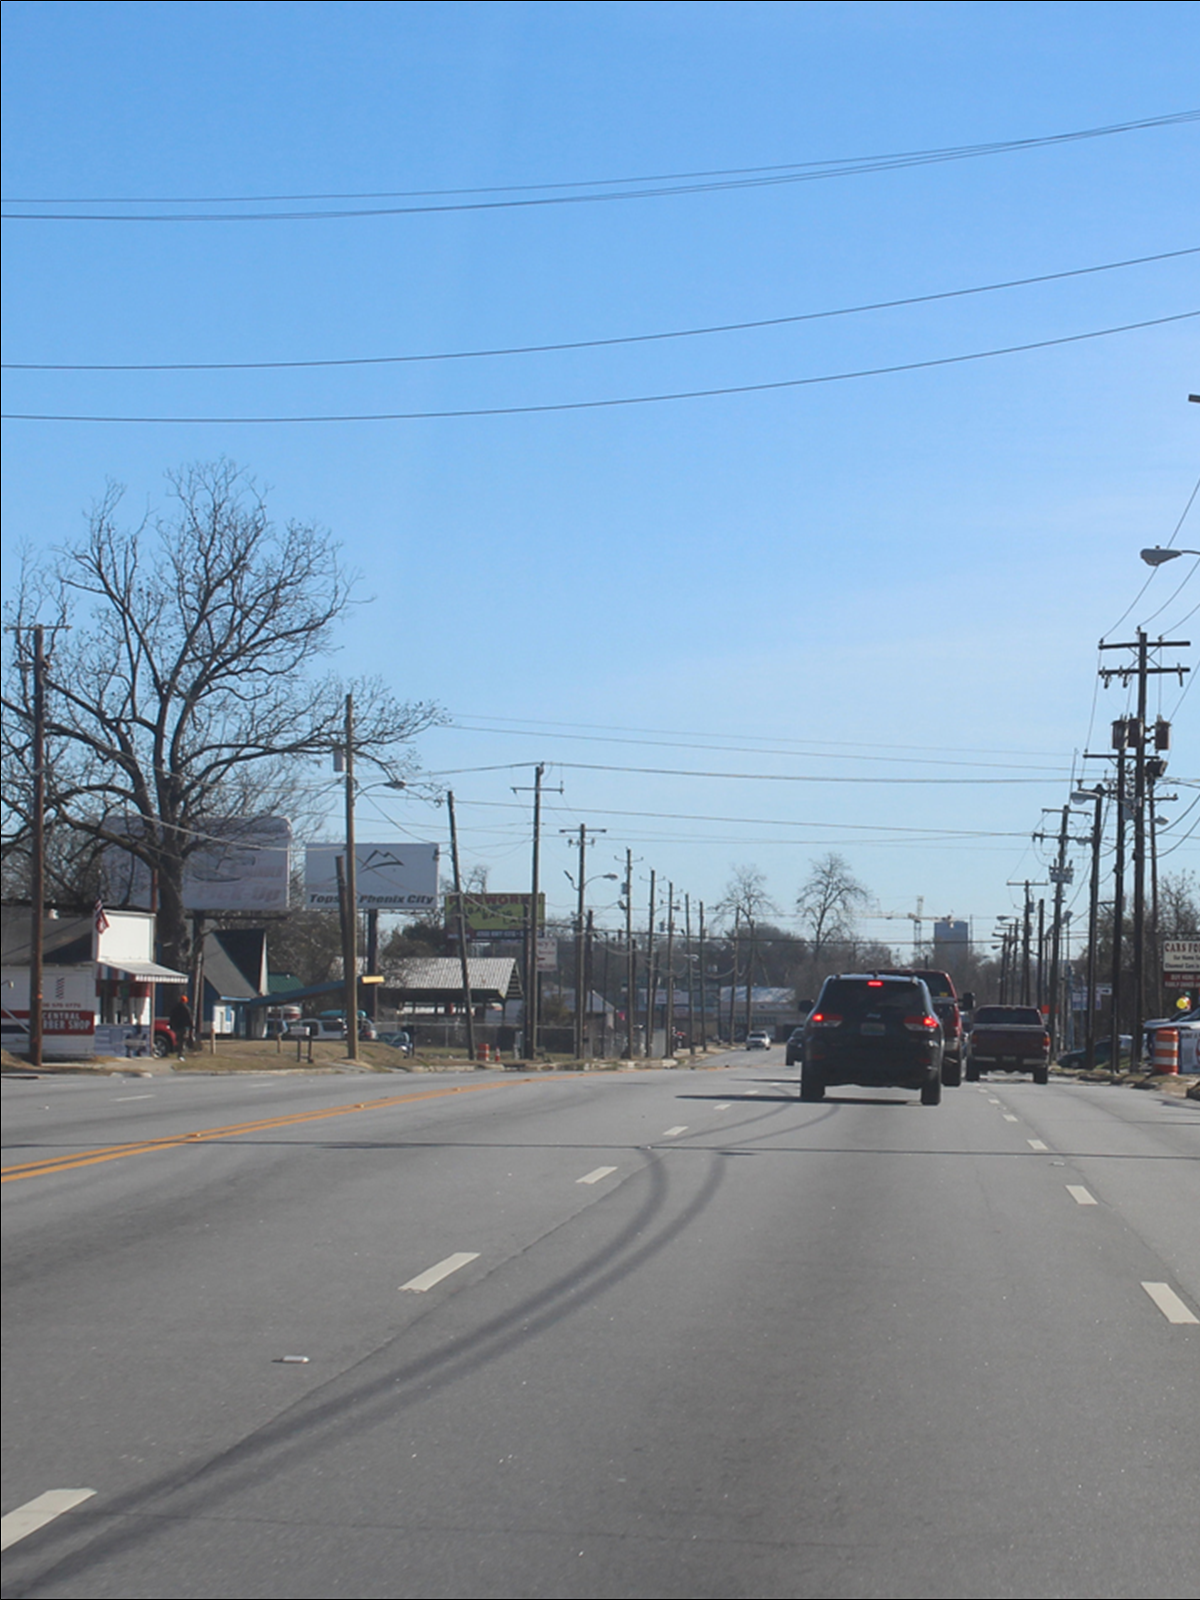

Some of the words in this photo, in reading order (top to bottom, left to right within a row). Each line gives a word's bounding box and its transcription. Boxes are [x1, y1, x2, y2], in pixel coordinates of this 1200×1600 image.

[359, 894, 405, 904] Phenix
[407, 894, 435, 905] City
[1165, 942, 1187, 953] CARS
[68, 1020, 91, 1031] SHOP
